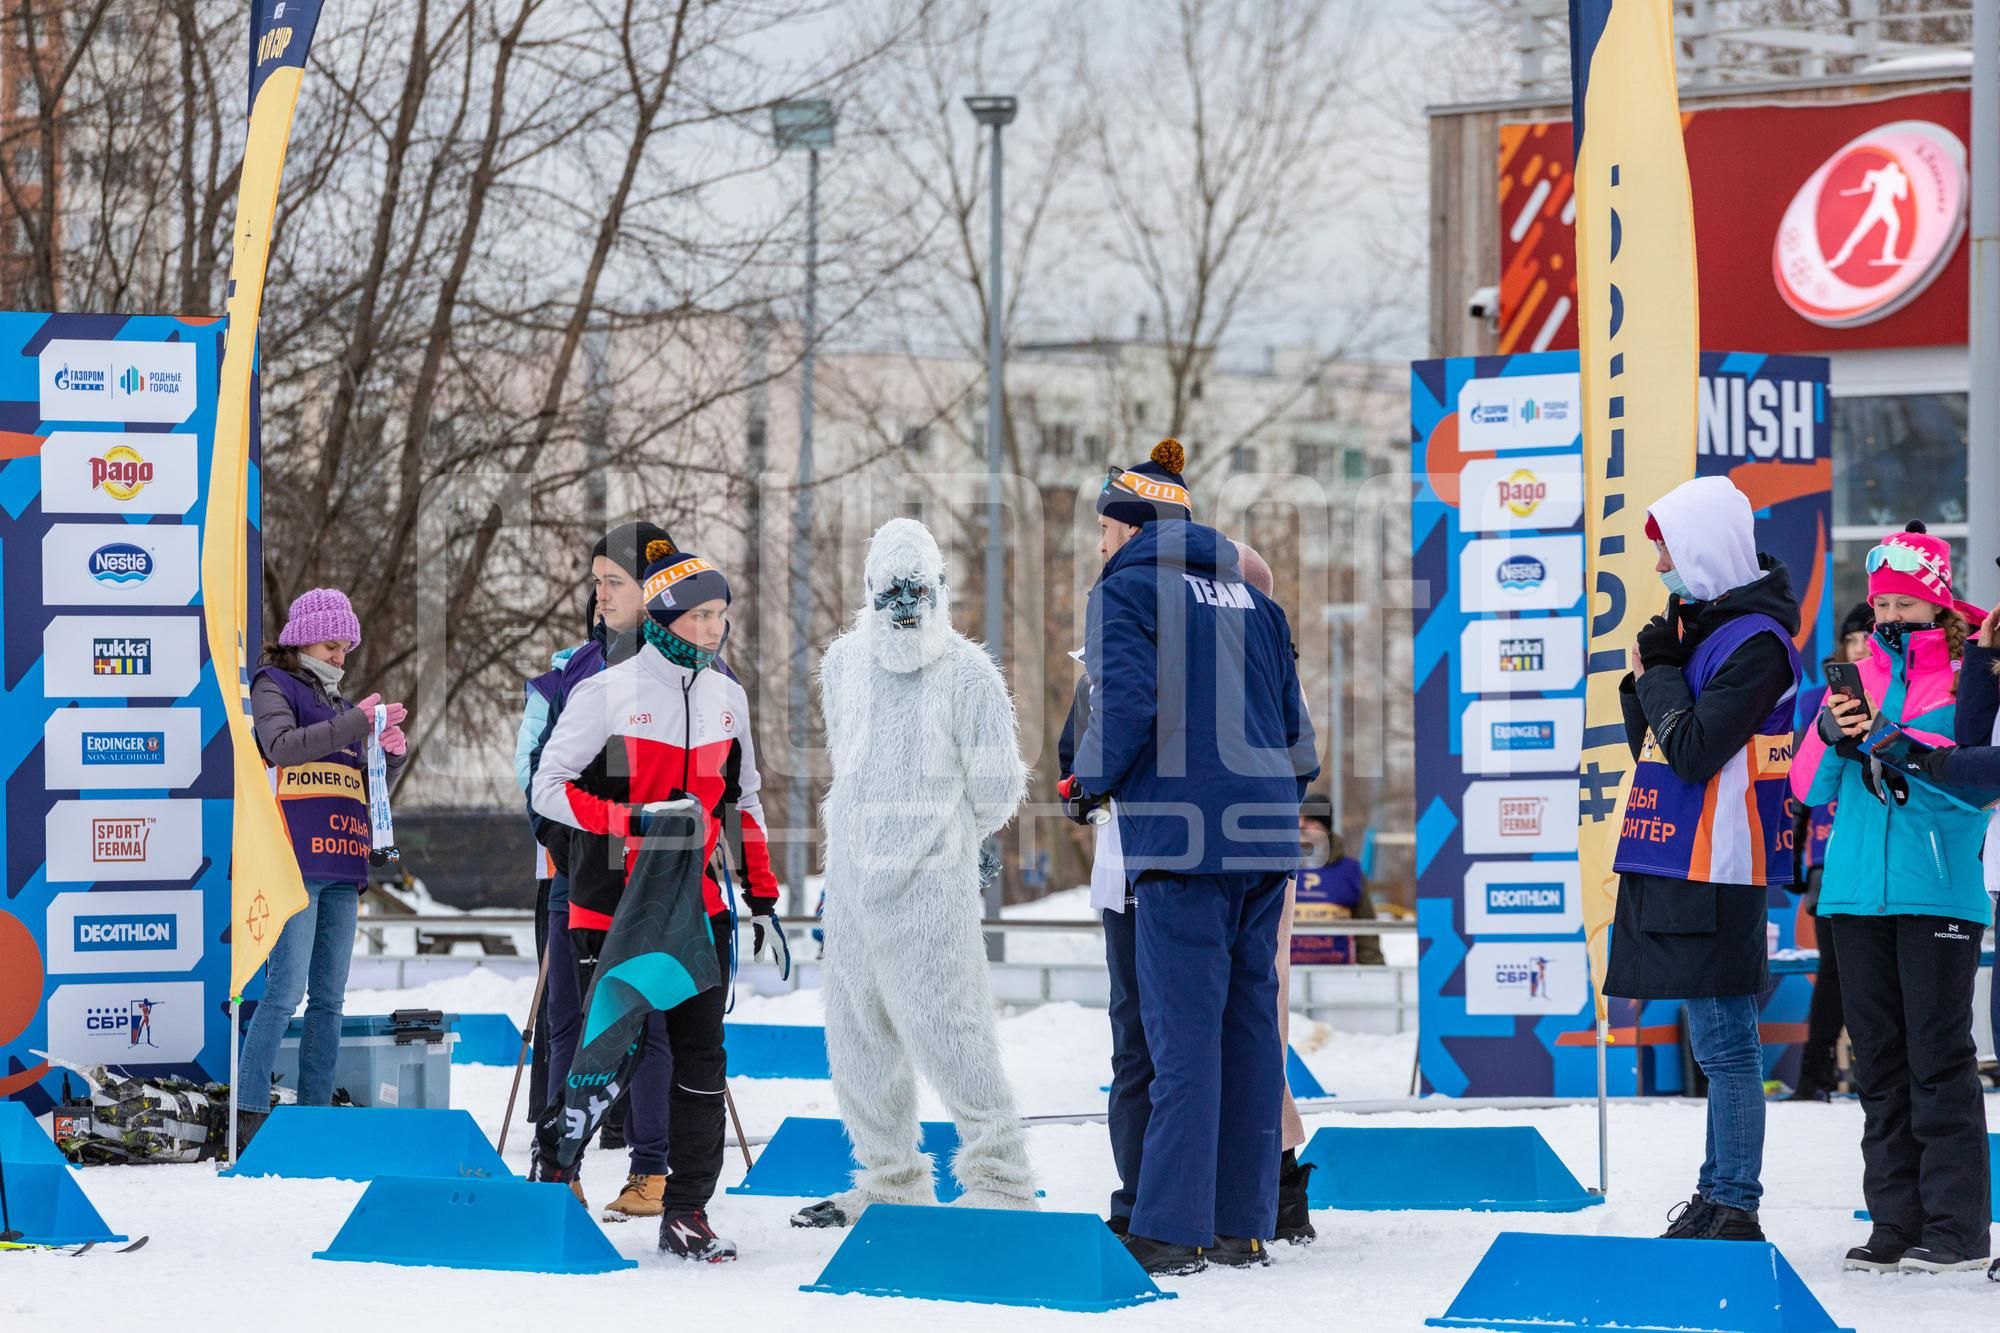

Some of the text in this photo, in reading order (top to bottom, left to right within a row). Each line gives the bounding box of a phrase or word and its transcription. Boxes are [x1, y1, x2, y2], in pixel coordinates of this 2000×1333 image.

[70, 370, 105, 382] ГАЗПРОМ
[150, 371, 182, 383] РОДНЫЕ
[150, 383, 180, 394] ГОРОДА
[1697, 376, 1814, 459] NISH
[1134, 478, 1176, 500] YOU
[96, 553, 147, 571] Nestlé
[1182, 573, 1256, 609] TEAM
[287, 772, 361, 792] PIONER CUP
[1503, 803, 1537, 816] SPORT
[97, 824, 141, 840] SPORT
[329, 814, 369, 838] СУДЬЯ
[1503, 818, 1538, 830] FERMA
[97, 841, 142, 857] FERMA
[1490, 889, 1560, 907] DECATHLON
[80, 923, 170, 943] DECATHLON
[1496, 971, 1528, 984] СБР
[87, 1016, 129, 1030] СБР
